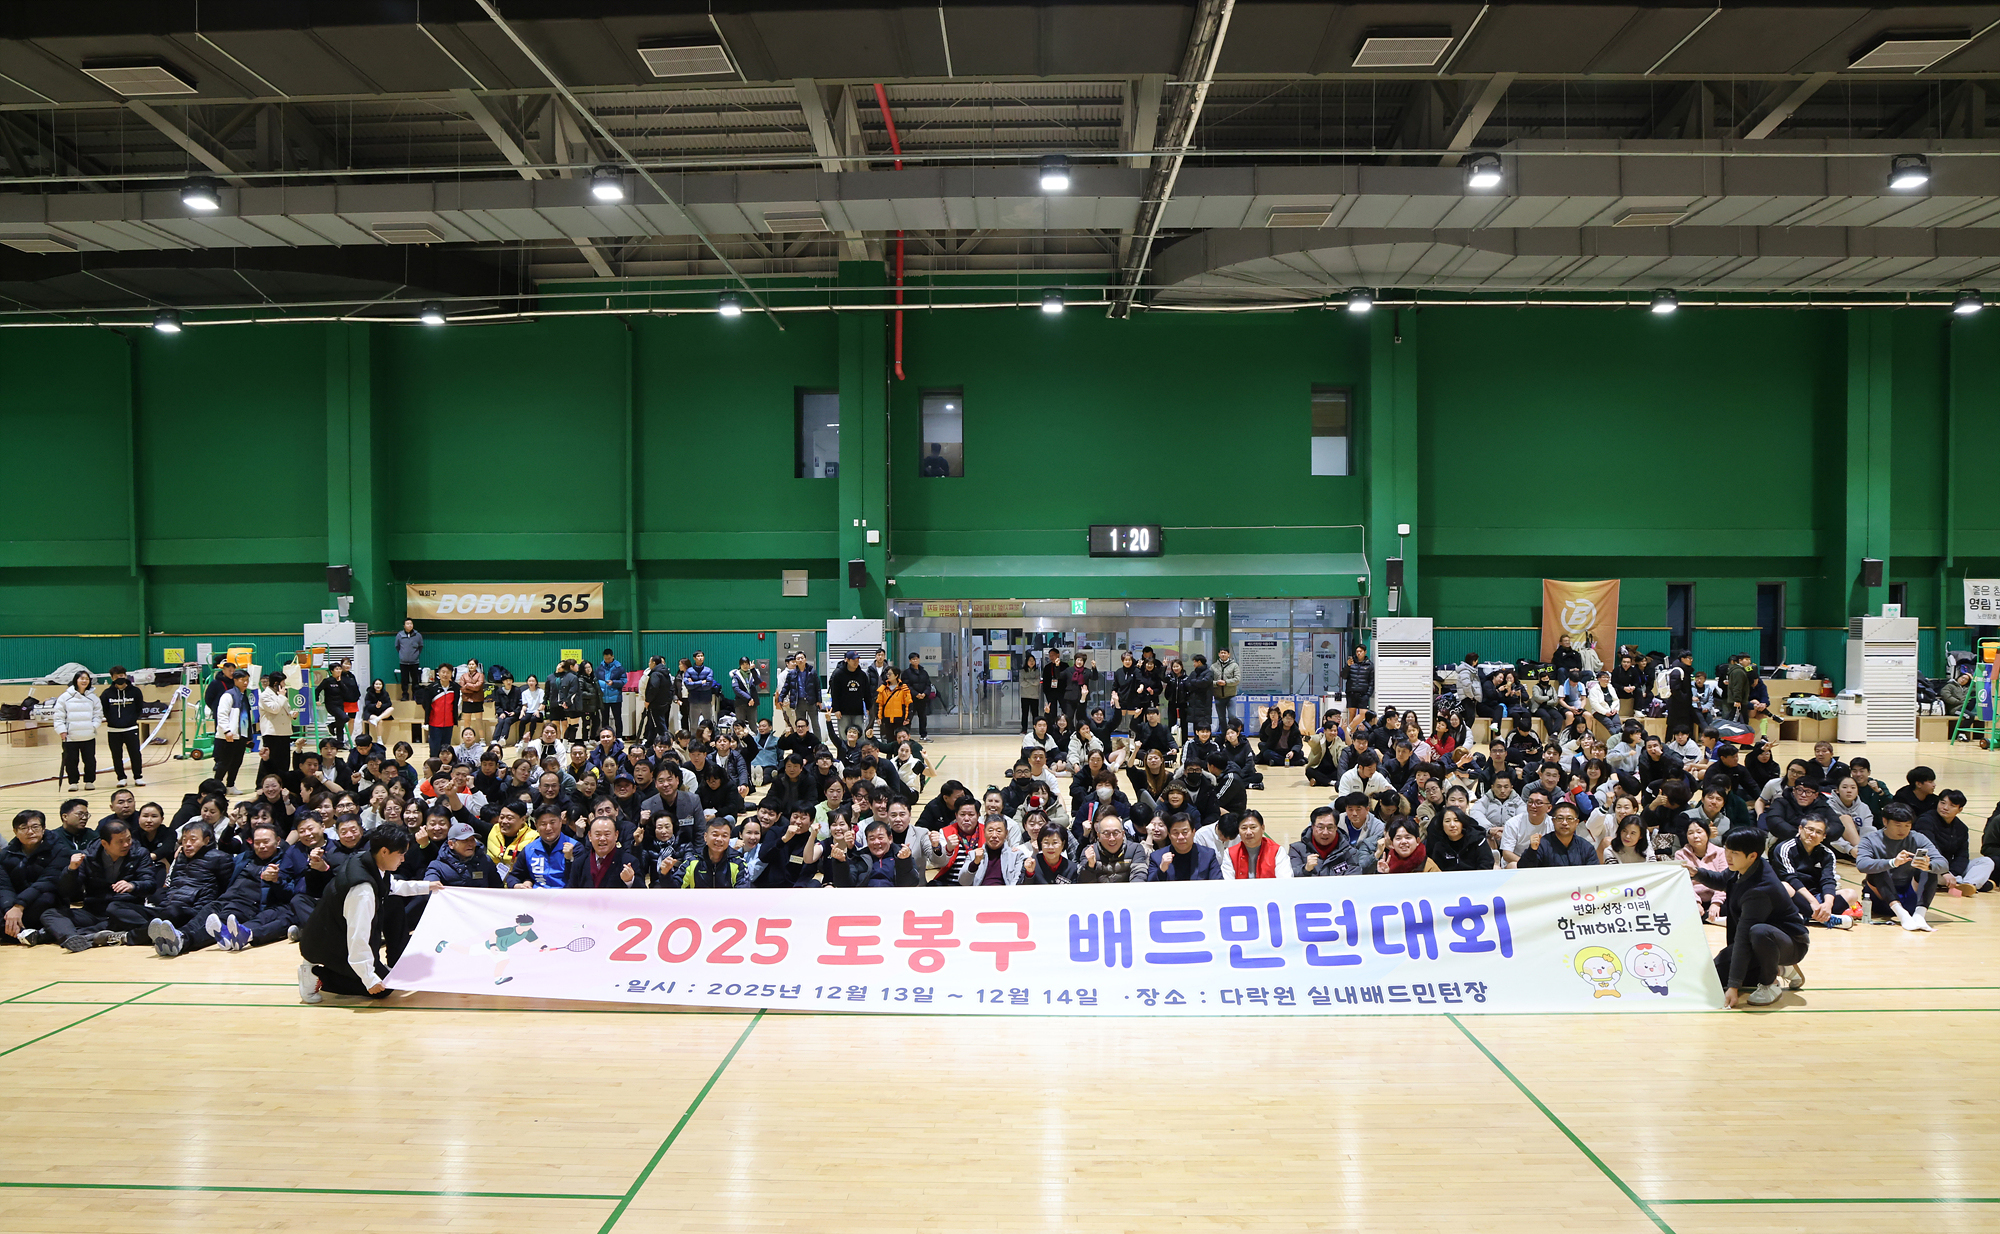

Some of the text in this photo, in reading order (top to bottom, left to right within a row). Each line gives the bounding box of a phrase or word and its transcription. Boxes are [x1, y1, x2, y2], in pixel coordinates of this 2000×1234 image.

[1109, 528, 1150, 551] 1:20
[436, 593, 591, 614] BOBON 365
[1969, 598, 1990, 610] 영림
[181, 687, 191, 697] 18
[609, 895, 1514, 974] 2025 도봉구 배드민턴대회
[1635, 912, 1672, 936] 도봉
[707, 982, 802, 1000] 2025년
[813, 984, 869, 1002] 12월
[881, 986, 936, 1003] 13일
[976, 986, 1030, 1005] 12월
[1043, 988, 1099, 1006] 14일
[1220, 985, 1297, 1006] 다락원
[1307, 980, 1489, 1006] 실내배드민턴장
